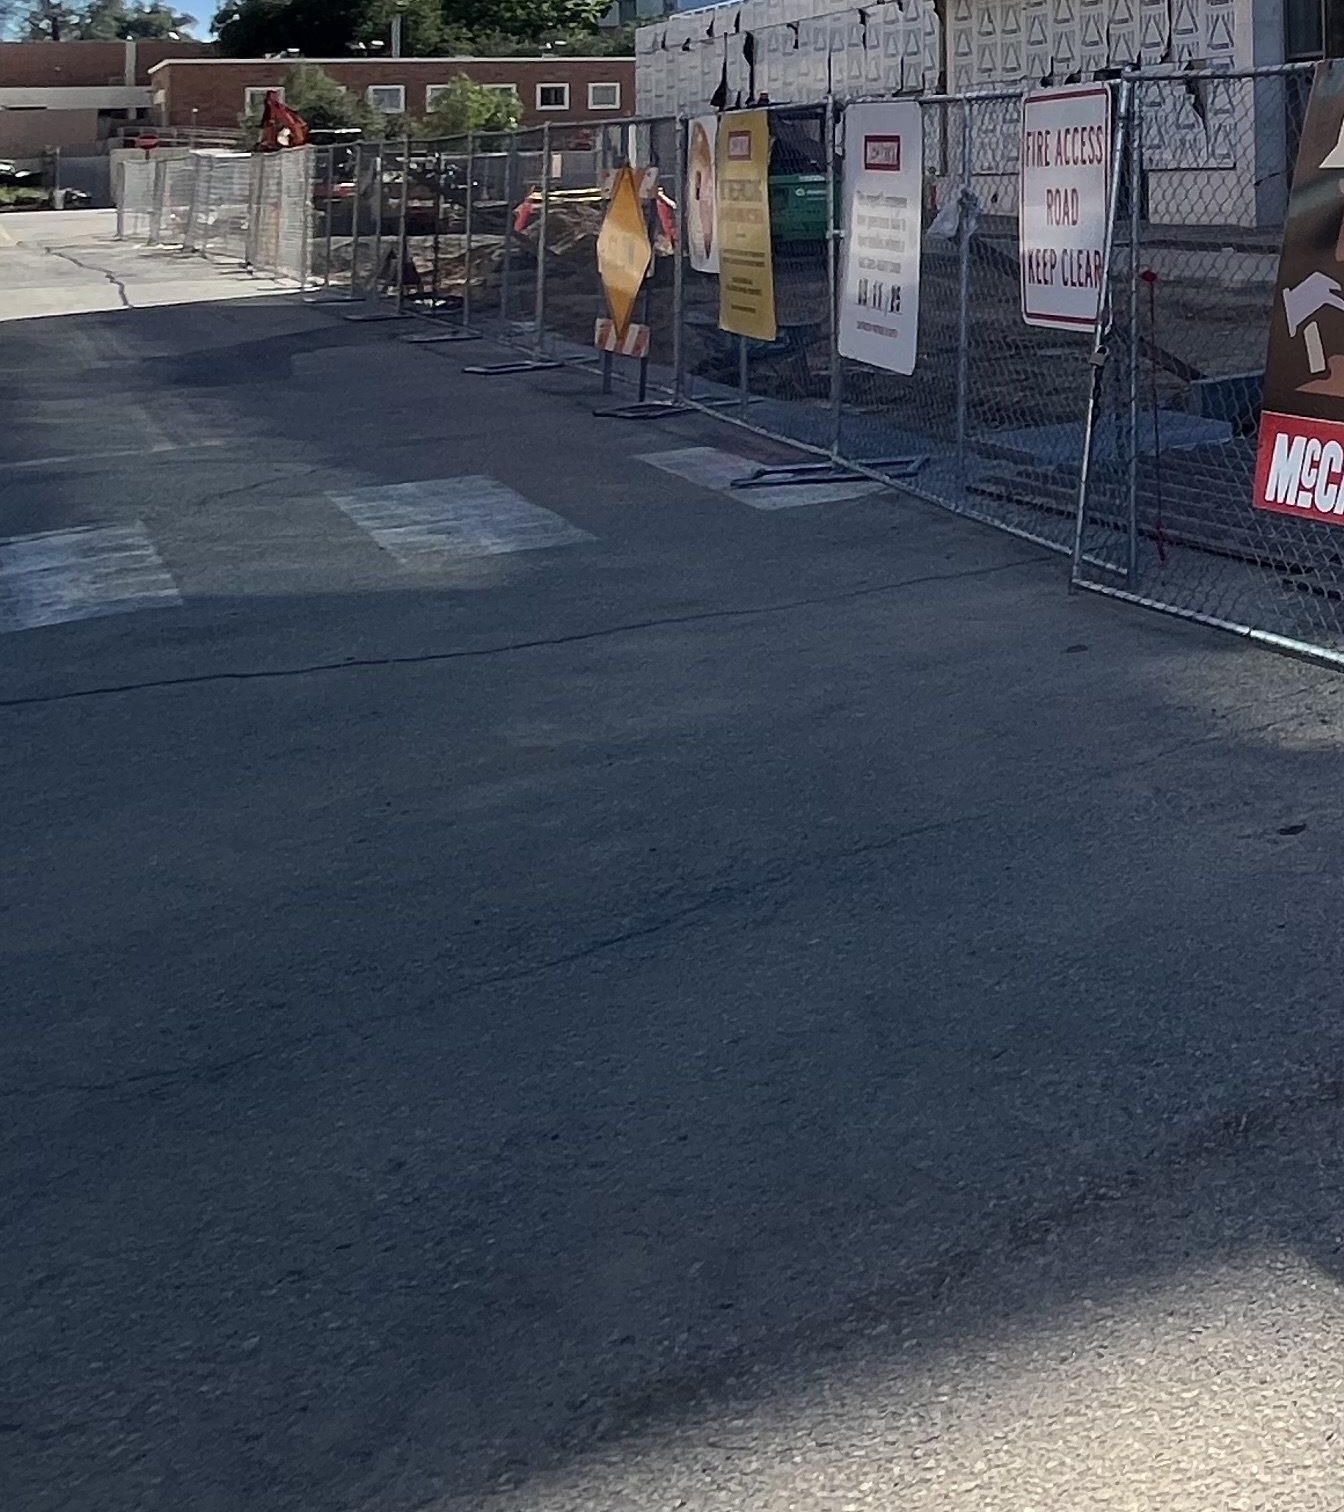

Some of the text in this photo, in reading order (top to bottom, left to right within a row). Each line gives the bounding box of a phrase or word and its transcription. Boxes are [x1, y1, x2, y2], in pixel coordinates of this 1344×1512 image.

[1026, 125, 1104, 168] FIRE ACCESS
[1046, 188, 1080, 226] ROAD
[1028, 249, 1102, 288] KEEP CLEAR
